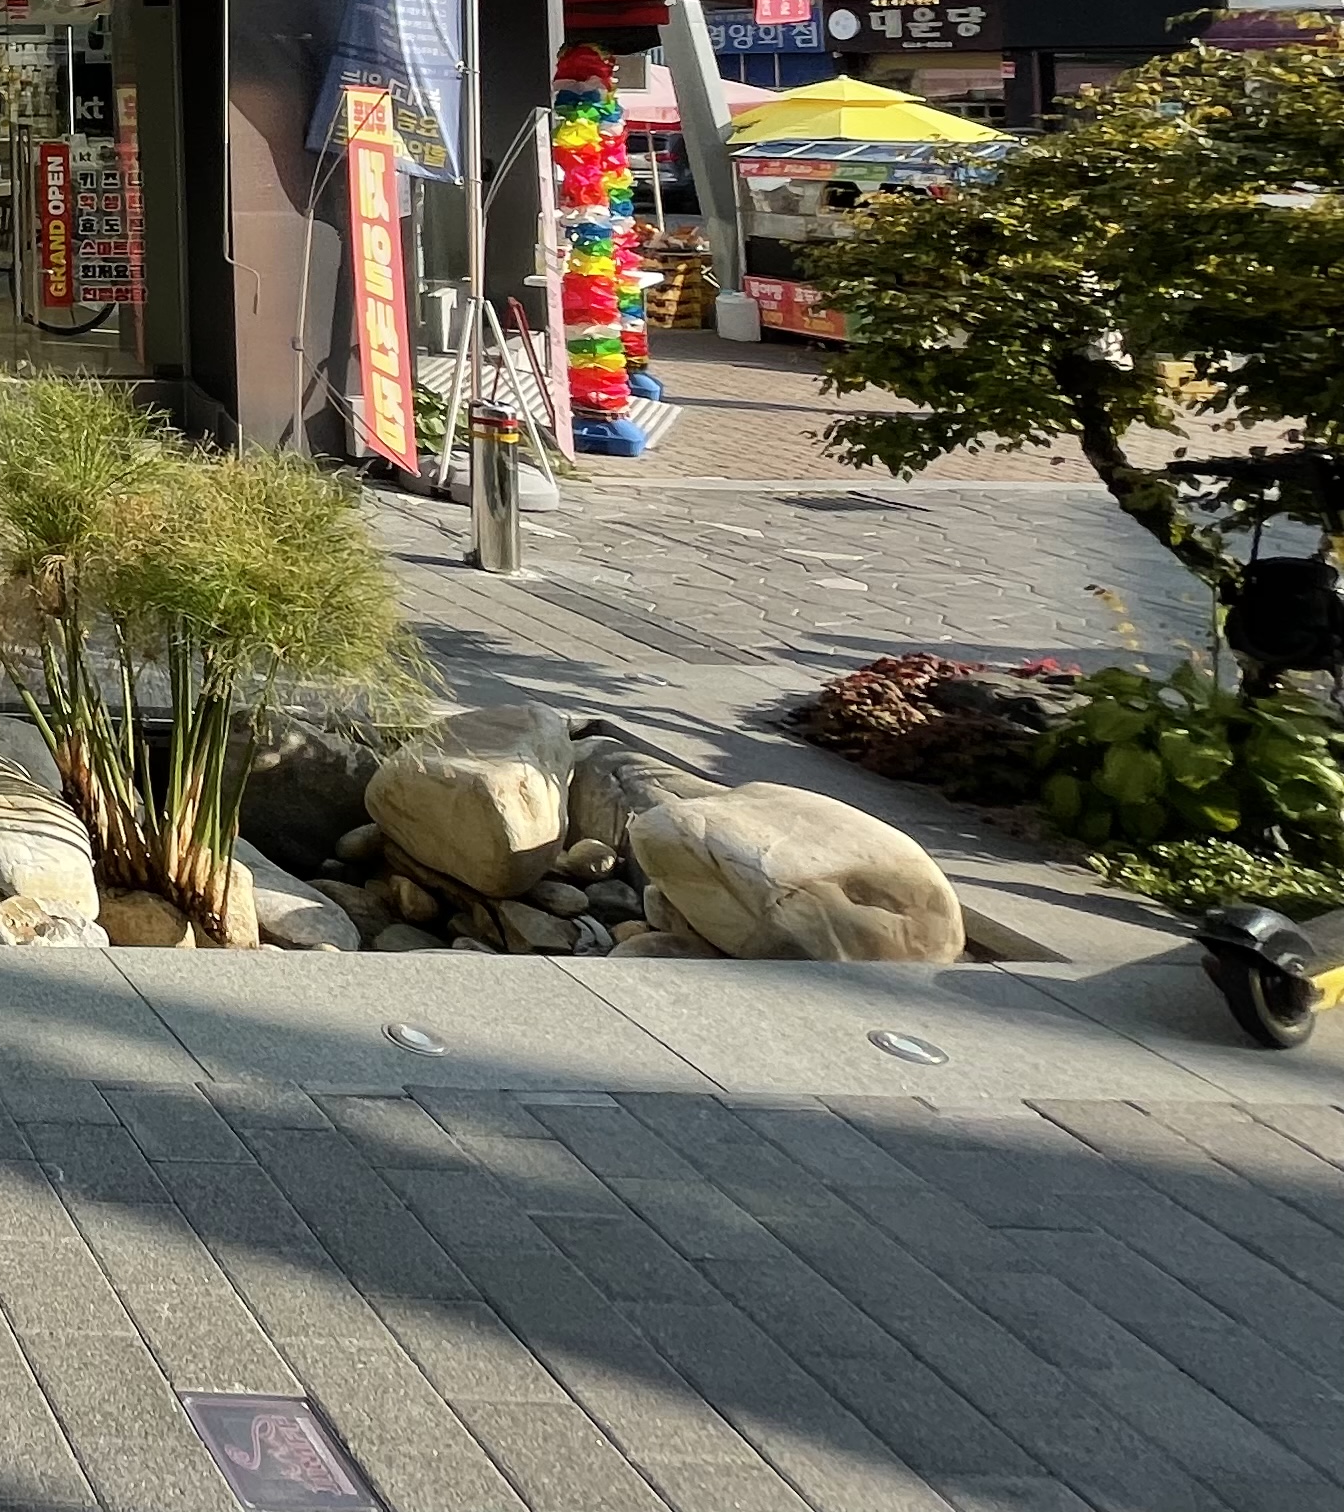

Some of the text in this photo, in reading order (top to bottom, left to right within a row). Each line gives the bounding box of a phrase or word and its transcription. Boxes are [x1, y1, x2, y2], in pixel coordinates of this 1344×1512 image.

[869, 7, 986, 38] 대운당
[75, 96, 104, 120] kt
[47, 156, 67, 298] GRAND OPEN
